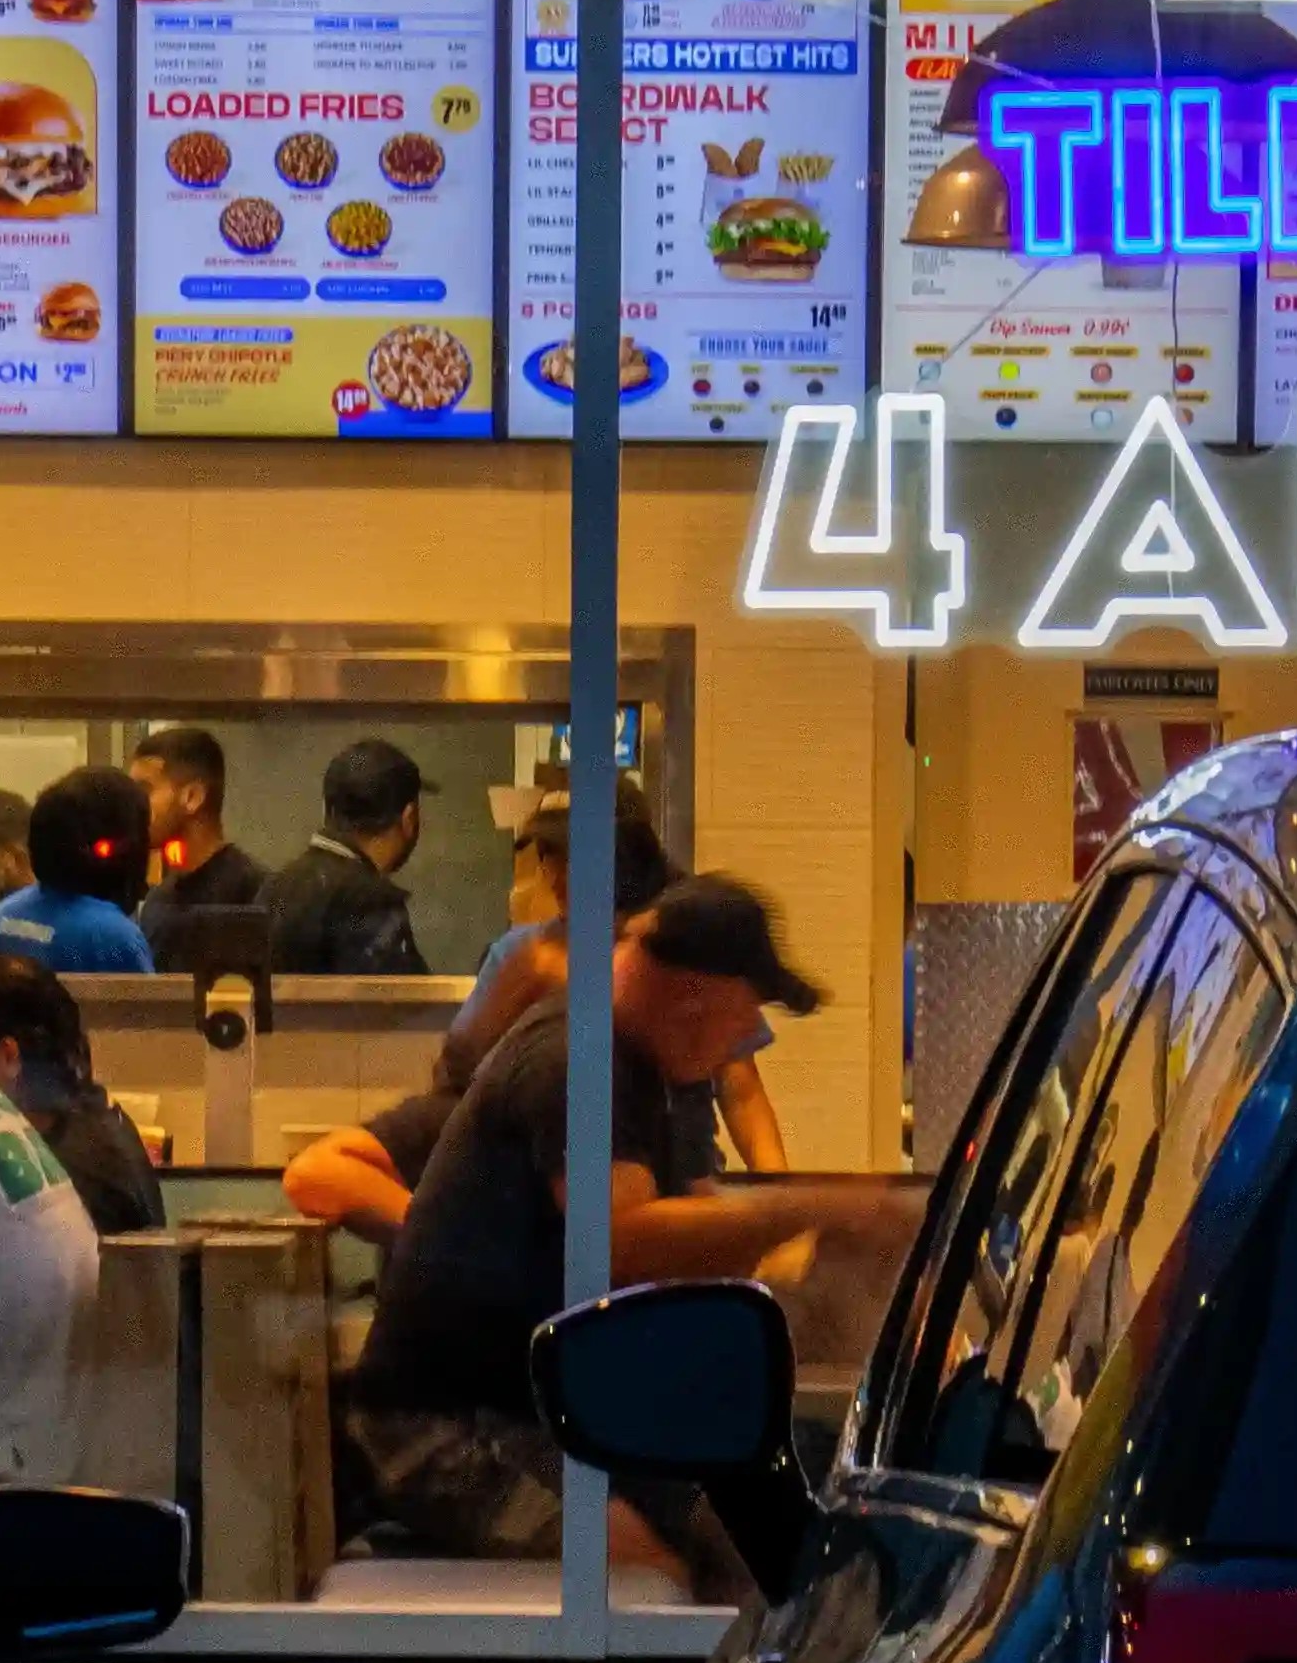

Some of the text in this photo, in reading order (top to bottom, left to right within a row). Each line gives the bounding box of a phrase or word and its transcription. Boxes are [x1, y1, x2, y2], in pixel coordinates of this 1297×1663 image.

[674, 41, 787, 69] HOTTEST
[792, 42, 849, 70] HITS
[147, 91, 290, 121] LOADED
[299, 92, 405, 122] FRIES
[529, 83, 770, 114] BORDWALK
[529, 117, 668, 145] SECT
[229, 367, 280, 384] FRIES
[743, 392, 966, 648] 4
